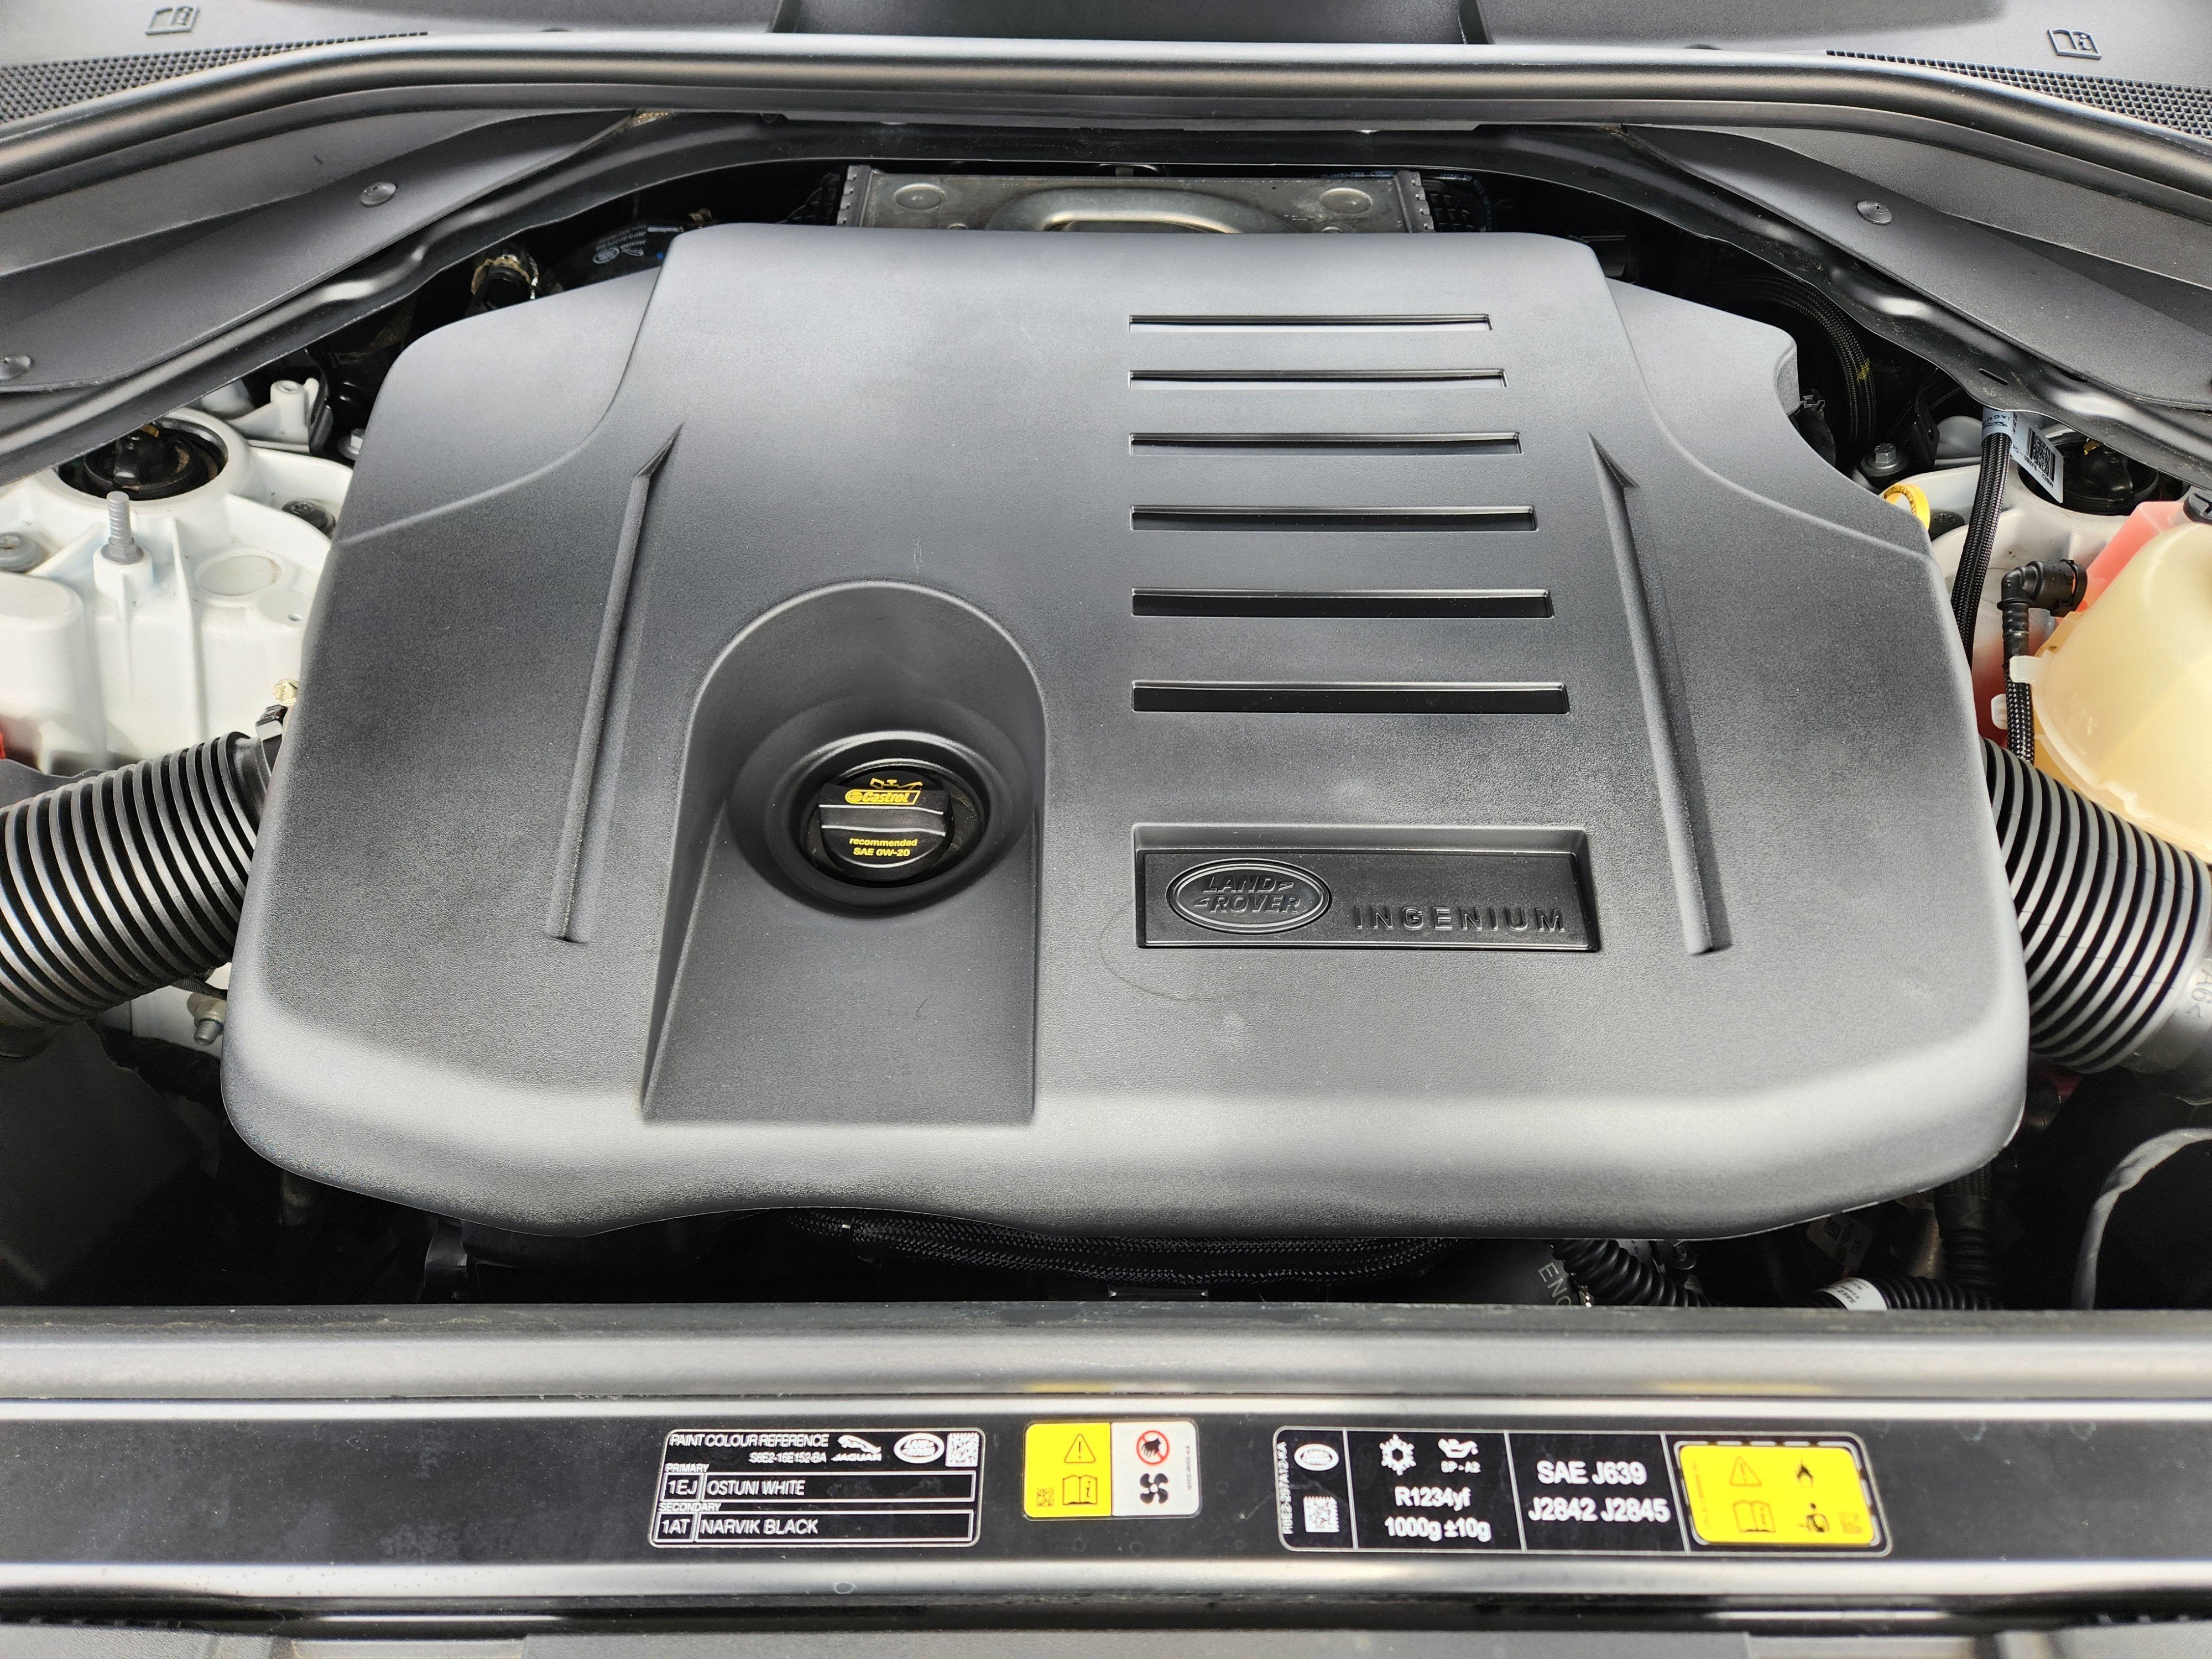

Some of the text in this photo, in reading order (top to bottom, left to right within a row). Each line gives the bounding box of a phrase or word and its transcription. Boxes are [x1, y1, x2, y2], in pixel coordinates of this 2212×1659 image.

[1983, 415, 2011, 426] JAGU
[862, 792, 910, 803] Castrol
[849, 837, 918, 847] recommended
[853, 847, 911, 857] SAE 0W-20
[1202, 875, 1277, 894] LAND
[1209, 894, 1301, 914] ROVER
[1353, 905, 1566, 933] INGENIUM
[669, 1433, 830, 1448] PAINT COLOUR REFERENCE
[830, 1453, 882, 1462] JAGUAR
[665, 1463, 709, 1473] PRIMARY
[1536, 1460, 1647, 1485] SAE J639
[667, 1479, 806, 1495] 1EJ OSTUNI WHITE
[1395, 1486, 1471, 1511] R1234yf
[658, 1503, 721, 1511] SECONDARY
[1528, 1496, 1672, 1523] J2842 J2845
[661, 1519, 818, 1535] 1AT NARVIK BLACK
[1384, 1516, 1492, 1542] 1000g ±10g
